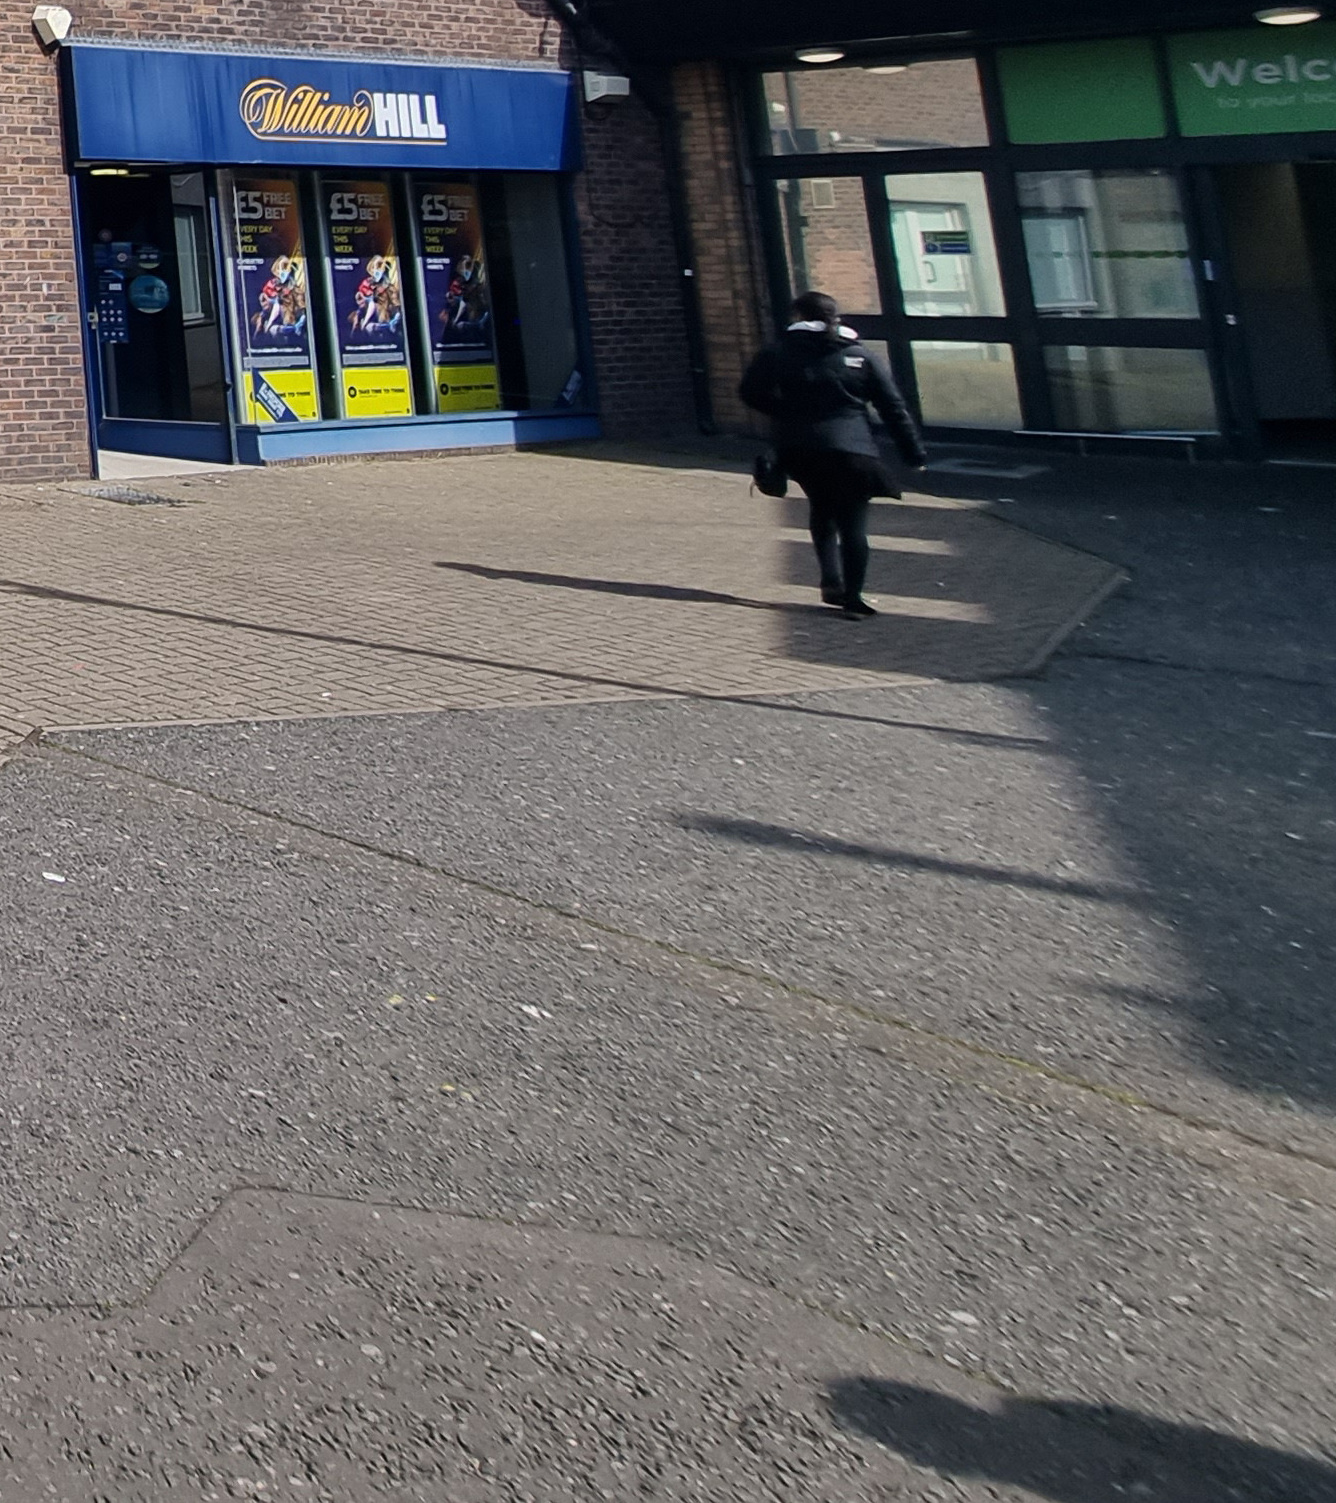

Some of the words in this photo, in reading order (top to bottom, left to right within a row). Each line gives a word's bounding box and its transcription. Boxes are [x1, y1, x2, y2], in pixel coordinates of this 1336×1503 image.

[1190, 54, 1336, 88] Welc
[239, 78, 374, 139] William
[373, 93, 447, 138] HILL
[262, 191, 292, 205] FREE
[330, 192, 358, 220] £5
[358, 193, 385, 206] FREE
[421, 193, 448, 221] £5
[264, 207, 286, 219] BET
[359, 208, 380, 220] BET
